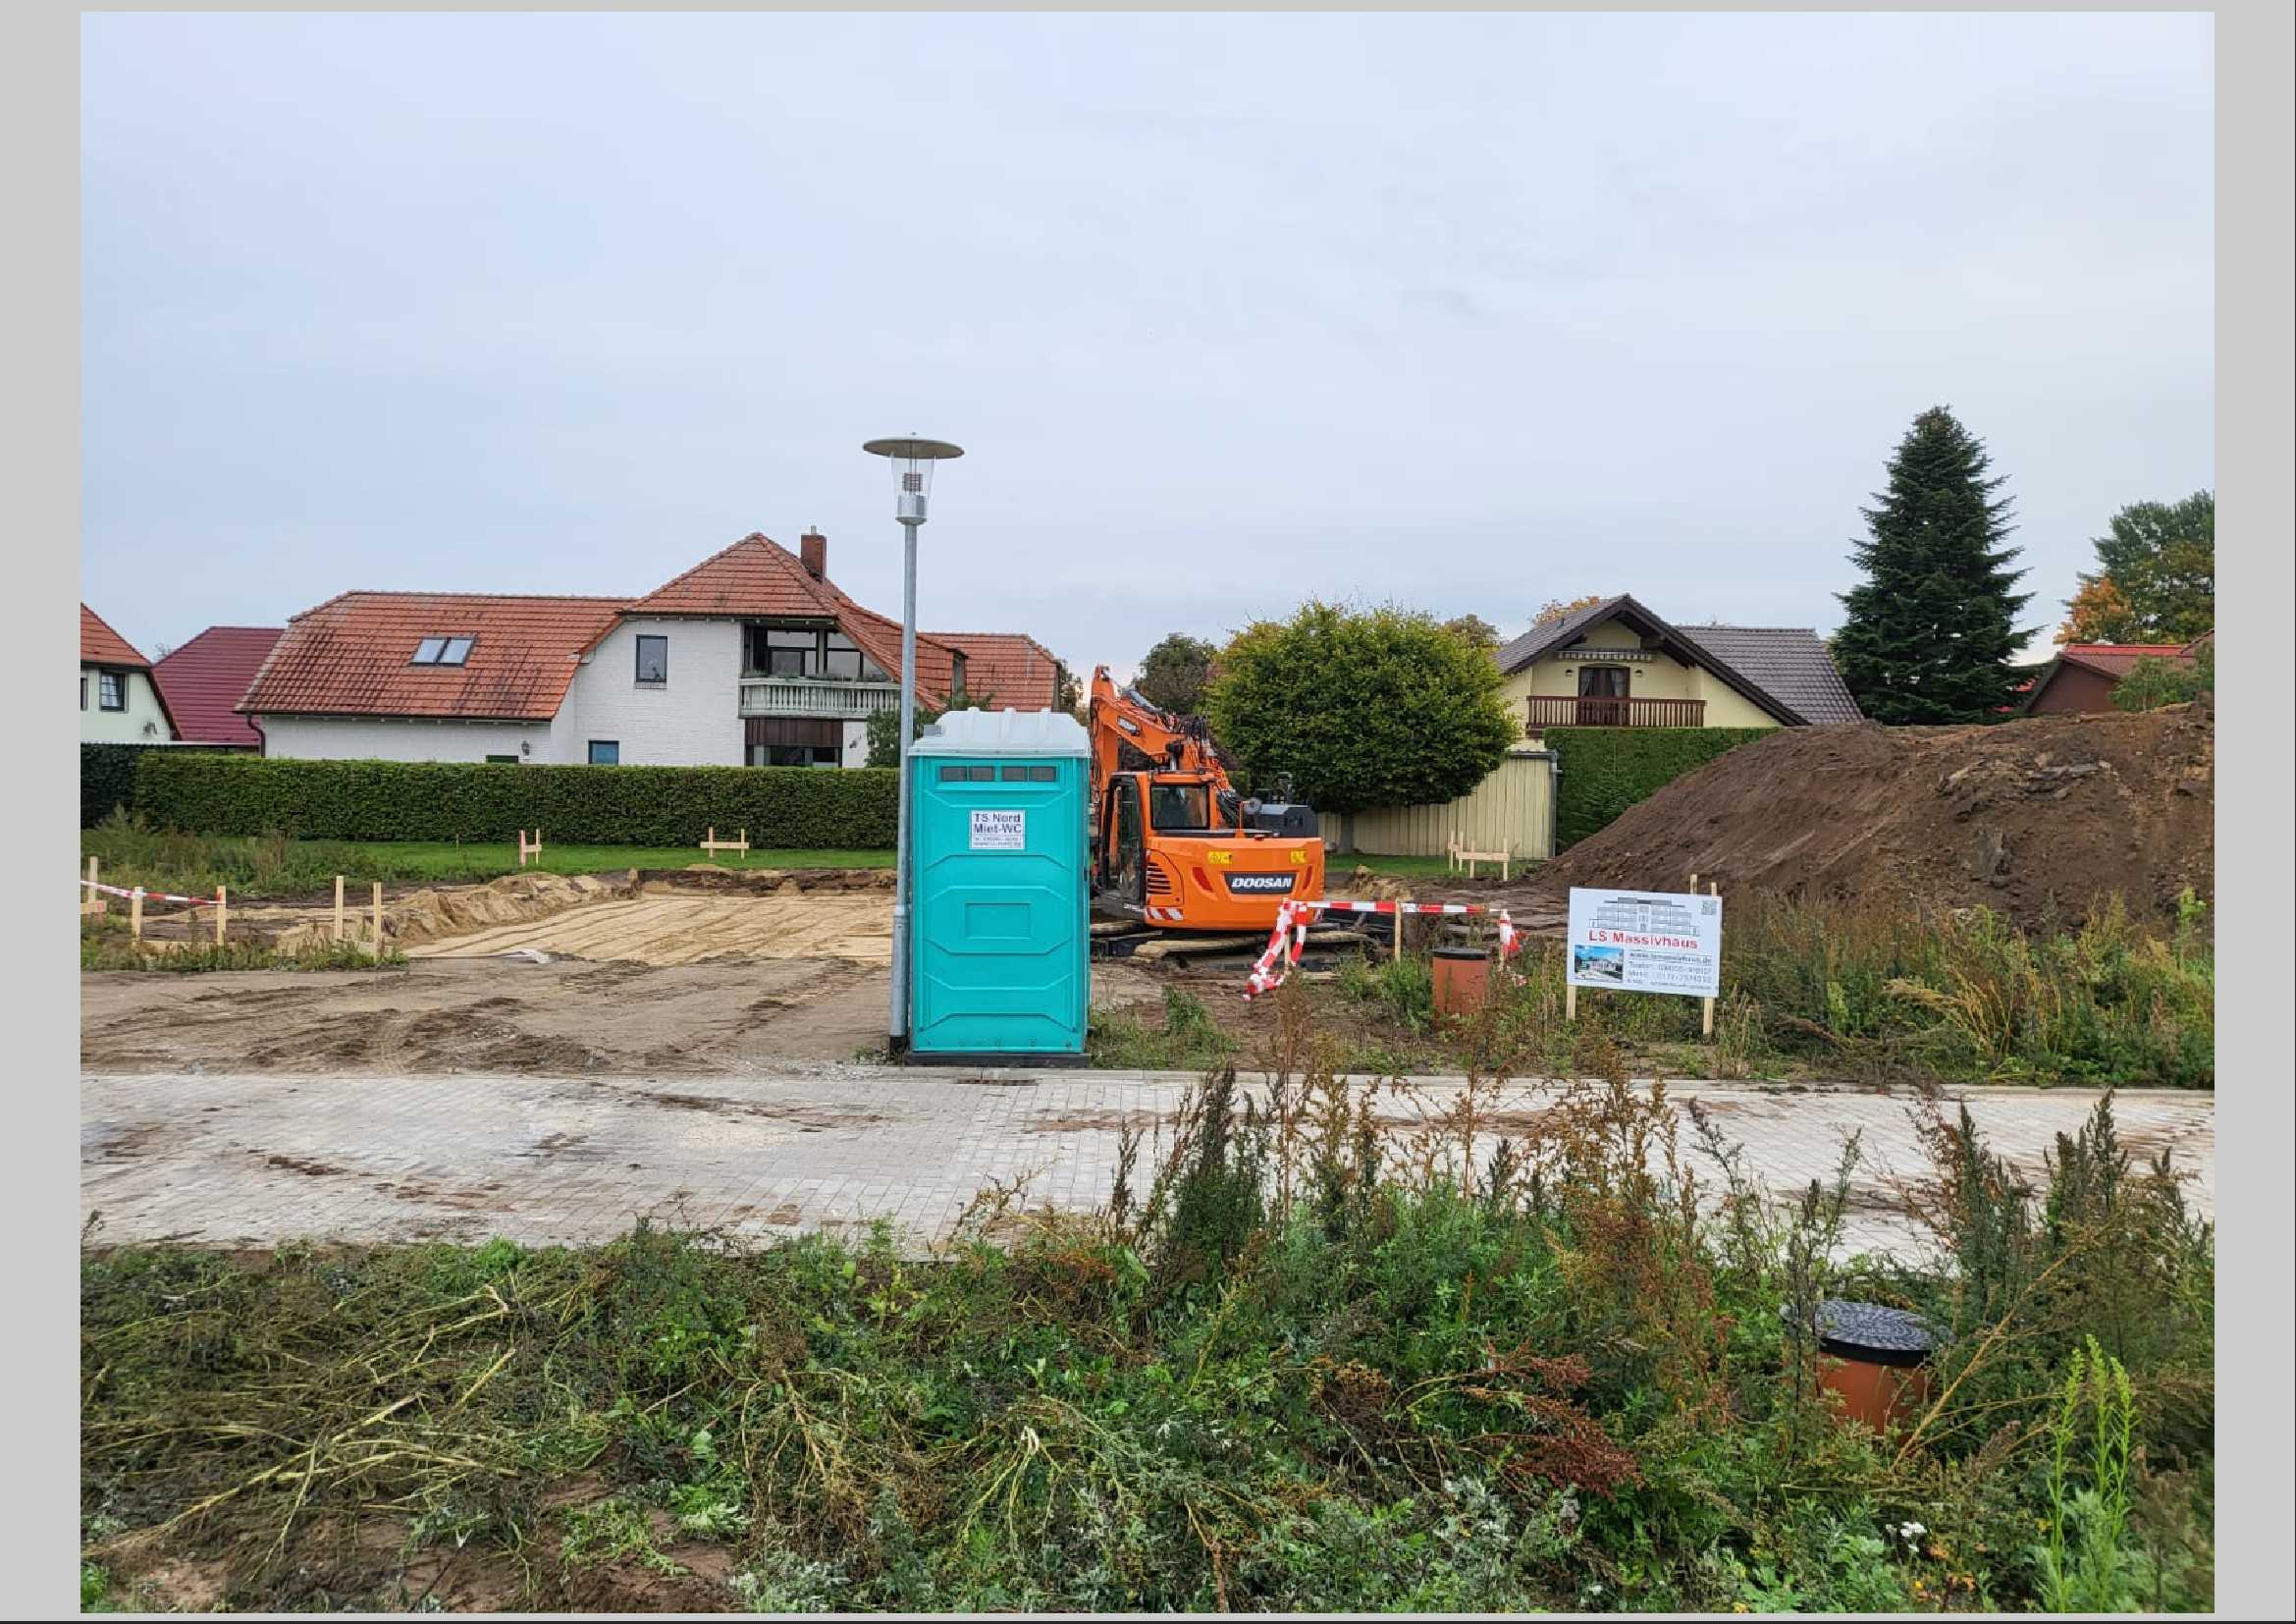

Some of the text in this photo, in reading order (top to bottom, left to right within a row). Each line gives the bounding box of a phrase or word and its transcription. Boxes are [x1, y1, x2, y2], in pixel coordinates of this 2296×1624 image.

[973, 813, 1021, 823] TS Nord
[973, 823, 1022, 834] Miet-WC
[1231, 877, 1292, 888] DOOSAN
[1588, 929, 1698, 949] LS Massivhaus
